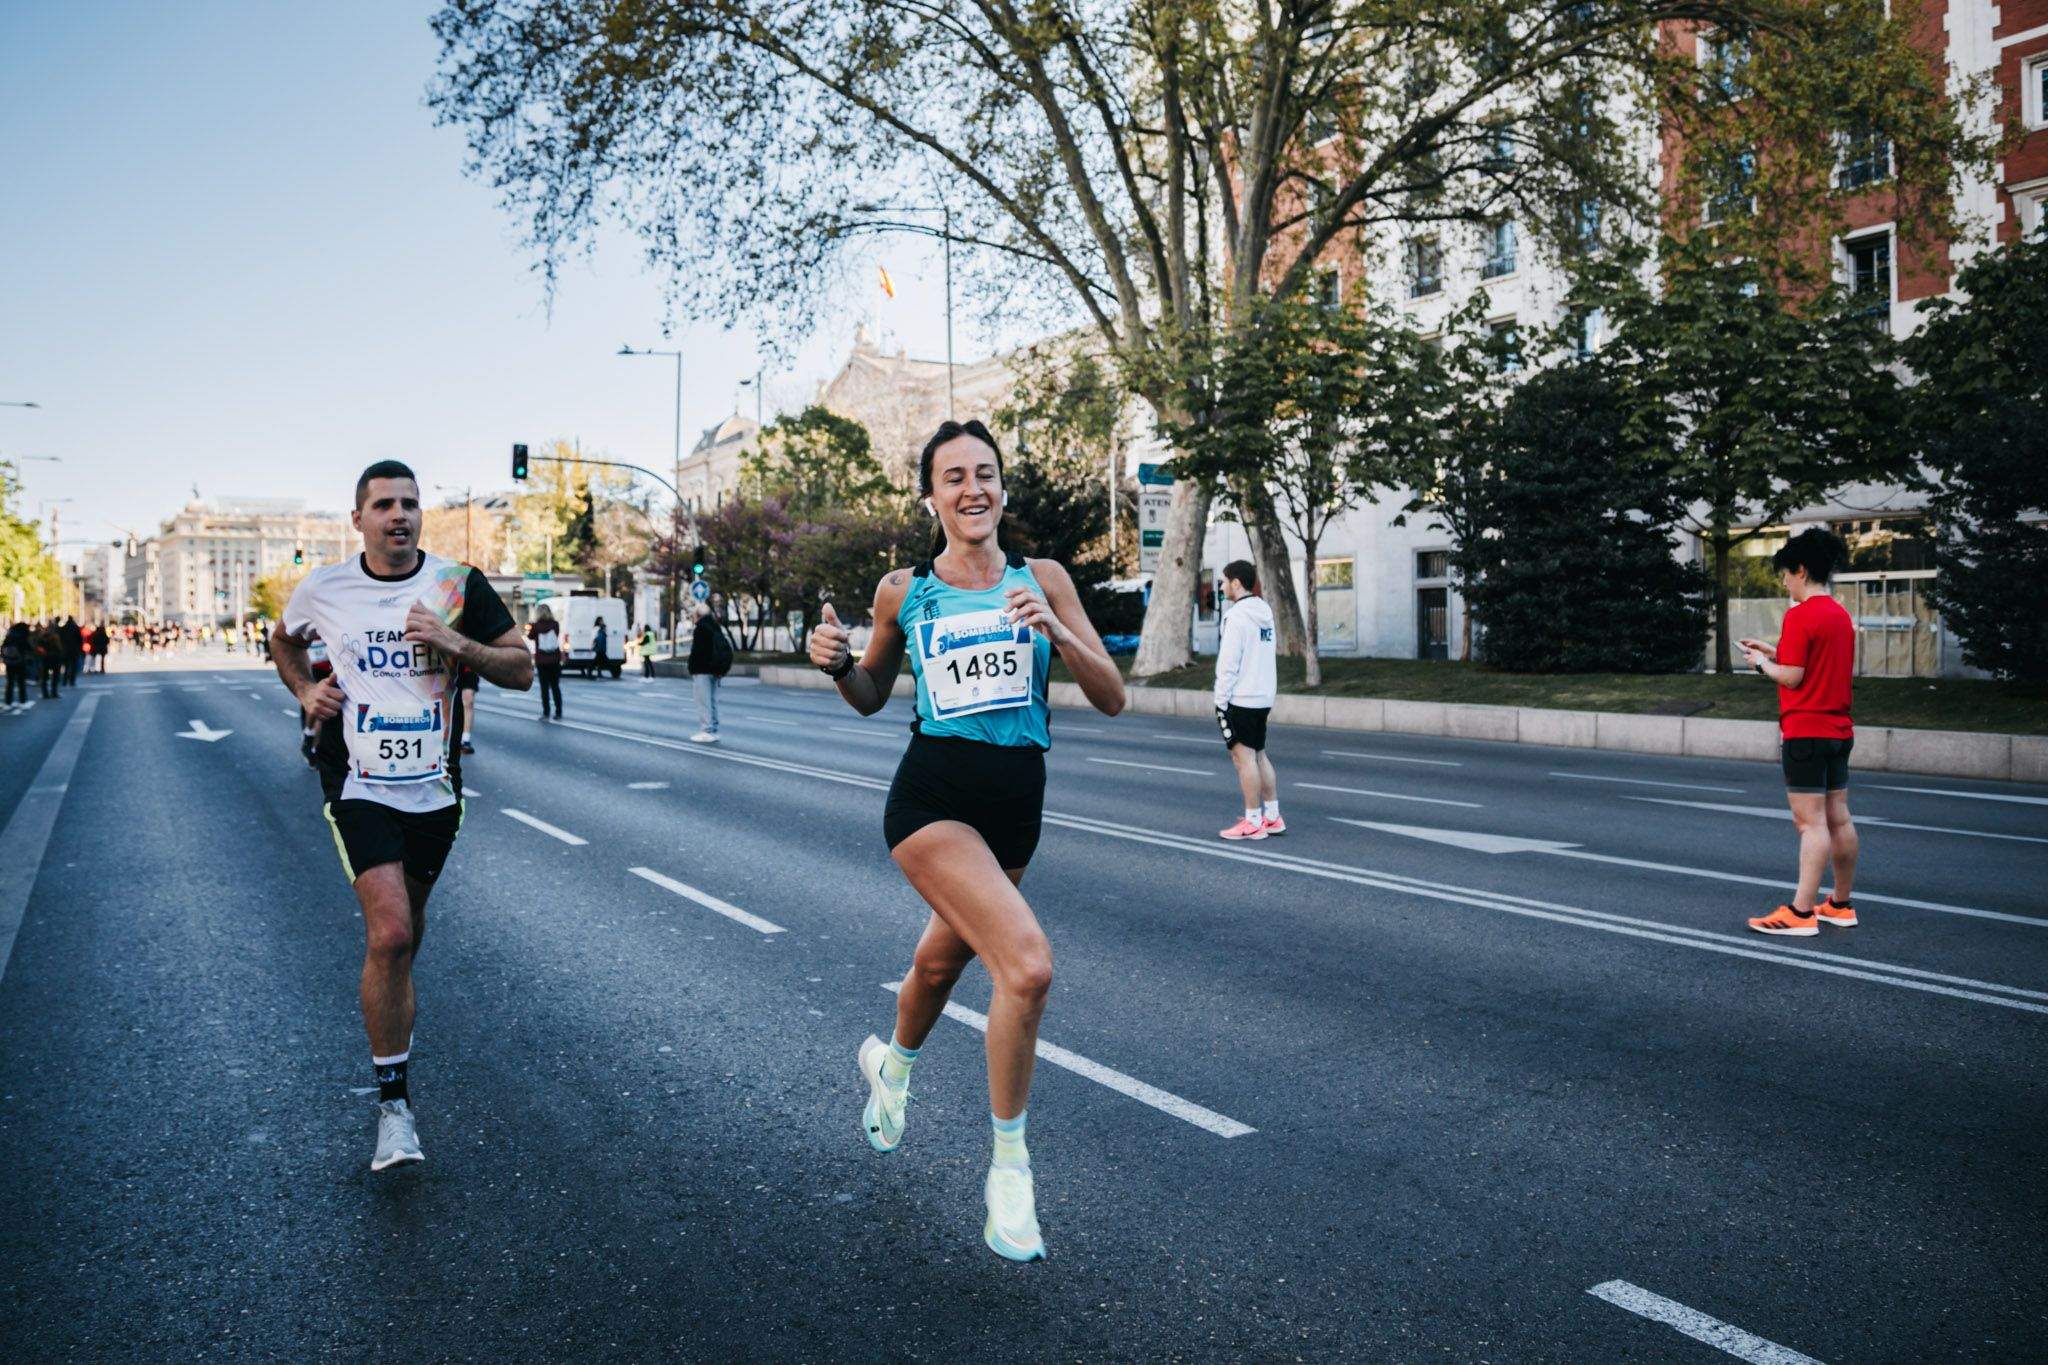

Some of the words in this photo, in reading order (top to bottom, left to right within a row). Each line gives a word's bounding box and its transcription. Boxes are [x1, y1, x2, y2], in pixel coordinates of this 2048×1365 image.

[953, 624, 1011, 640] BOMBEROS
[947, 650, 1018, 684] 1485
[379, 738, 421, 760] 531
